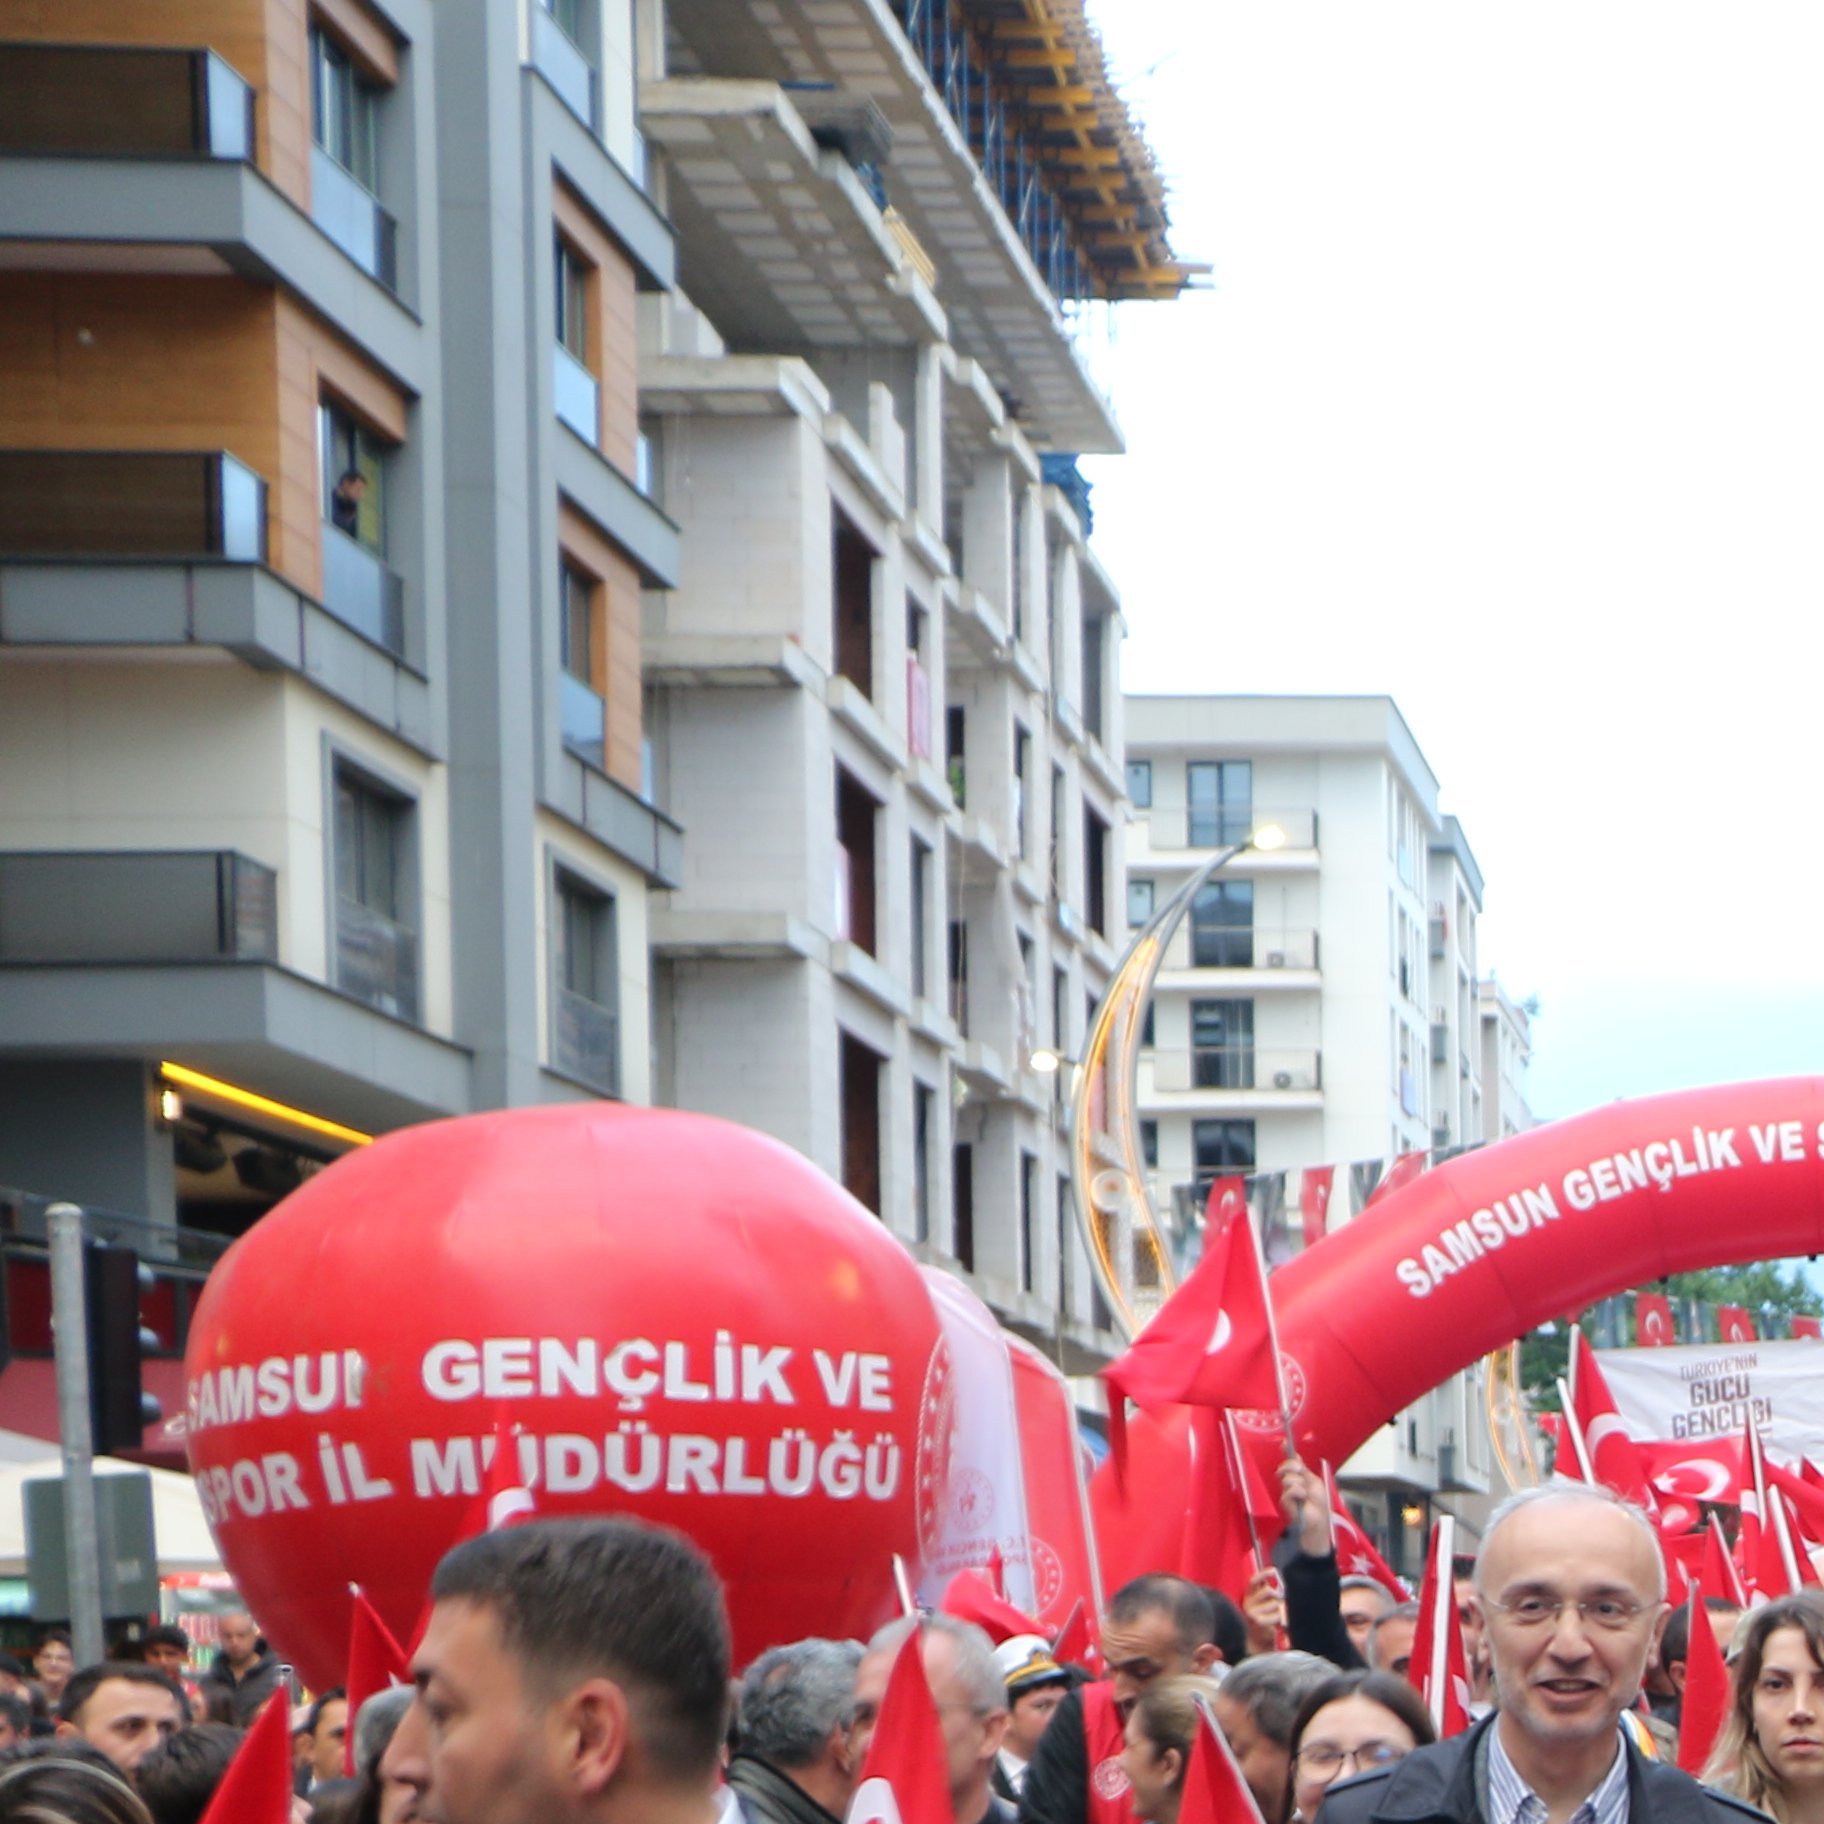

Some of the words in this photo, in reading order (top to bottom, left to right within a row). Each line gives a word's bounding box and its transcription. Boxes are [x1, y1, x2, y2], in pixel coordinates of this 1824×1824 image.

[1395, 1181, 1561, 1298] SAMSUN
[1562, 1125, 1742, 1212] GENÇLİK
[1747, 1120, 1806, 1163] VE
[421, 1329, 795, 1412] GENÇLİK
[812, 1348, 894, 1412] VE
[197, 1450, 311, 1524] SPOR
[317, 1431, 394, 1506] İL
